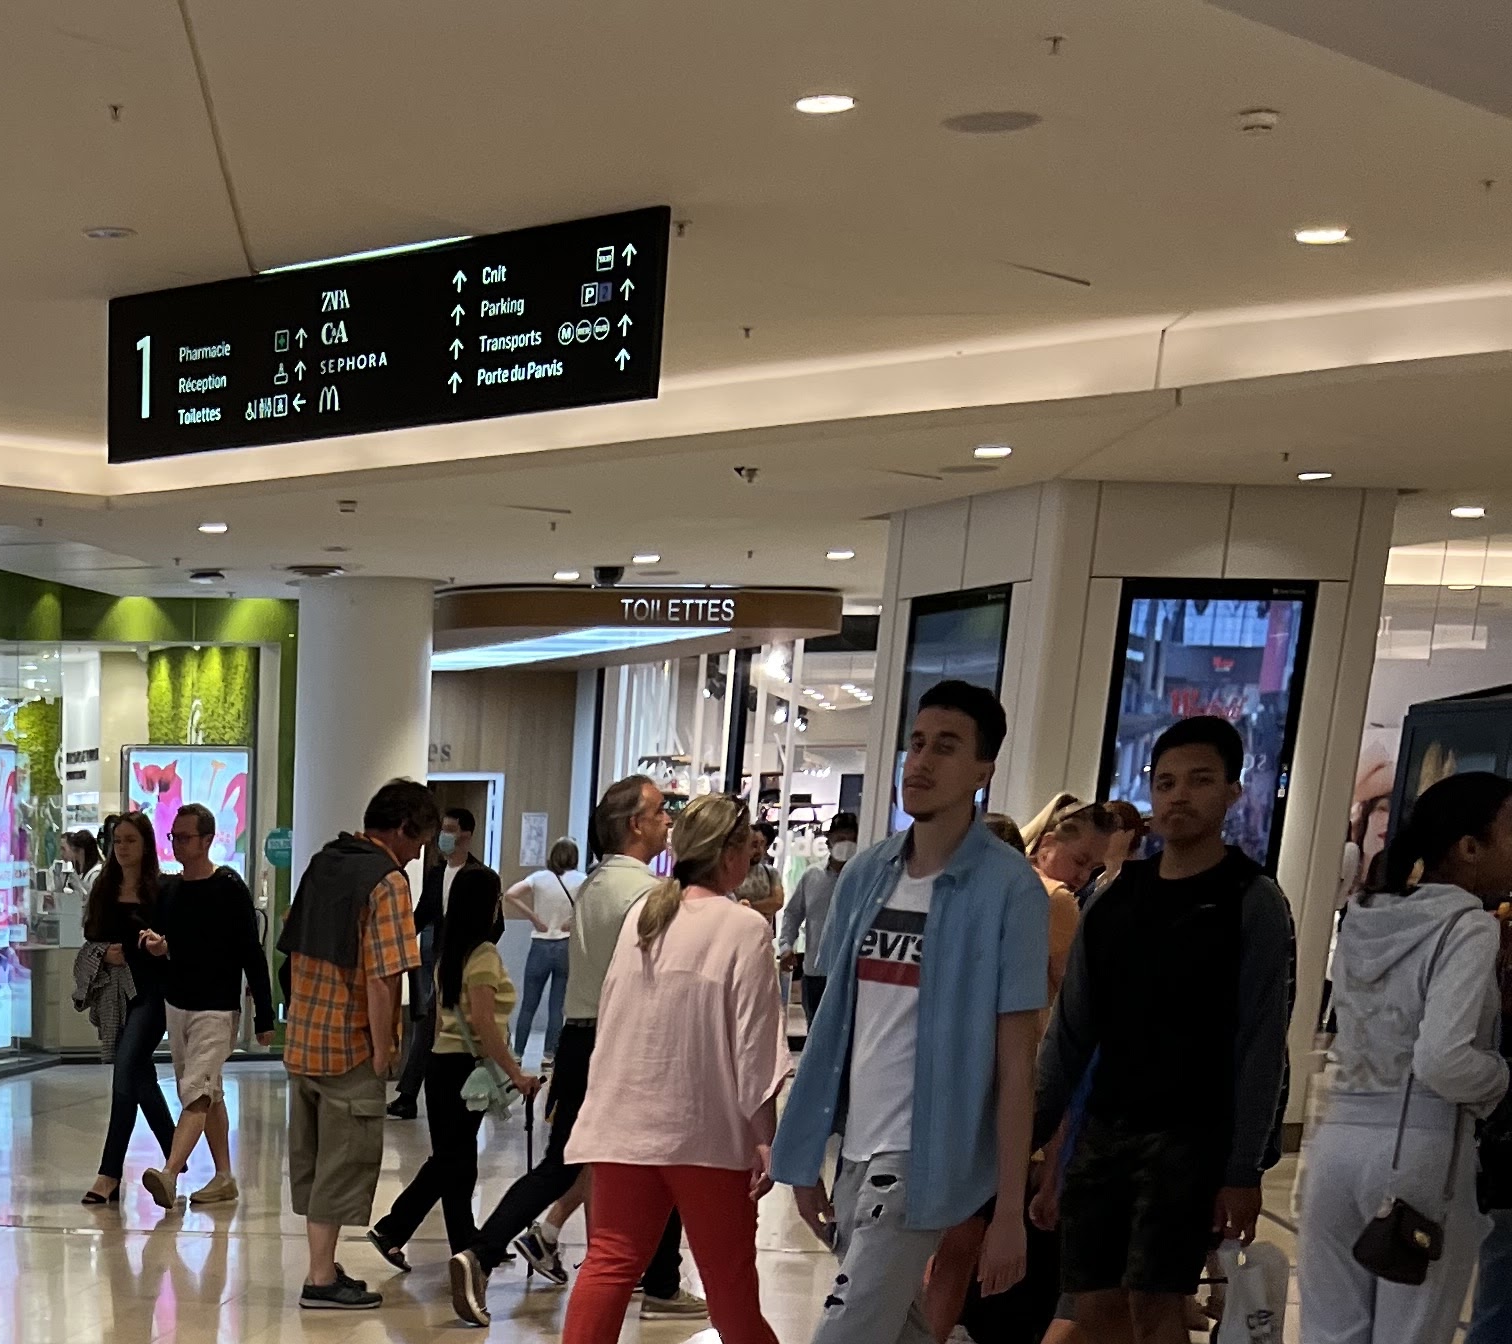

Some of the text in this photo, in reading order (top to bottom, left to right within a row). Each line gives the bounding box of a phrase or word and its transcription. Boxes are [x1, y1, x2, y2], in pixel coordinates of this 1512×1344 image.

[482, 265, 507, 285] Cnit
[321, 289, 351, 313] ZARA
[480, 297, 525, 318] Parking
[179, 341, 231, 362] Pharmacie
[479, 330, 542, 353] Transports
[319, 352, 388, 375] SEPHORA
[477, 359, 564, 386] Porte du Parvis
[136, 335, 151, 419] 1
[178, 374, 227, 394] Réception
[178, 406, 221, 426] Toilettes
[620, 598, 735, 622] TOILETTES
